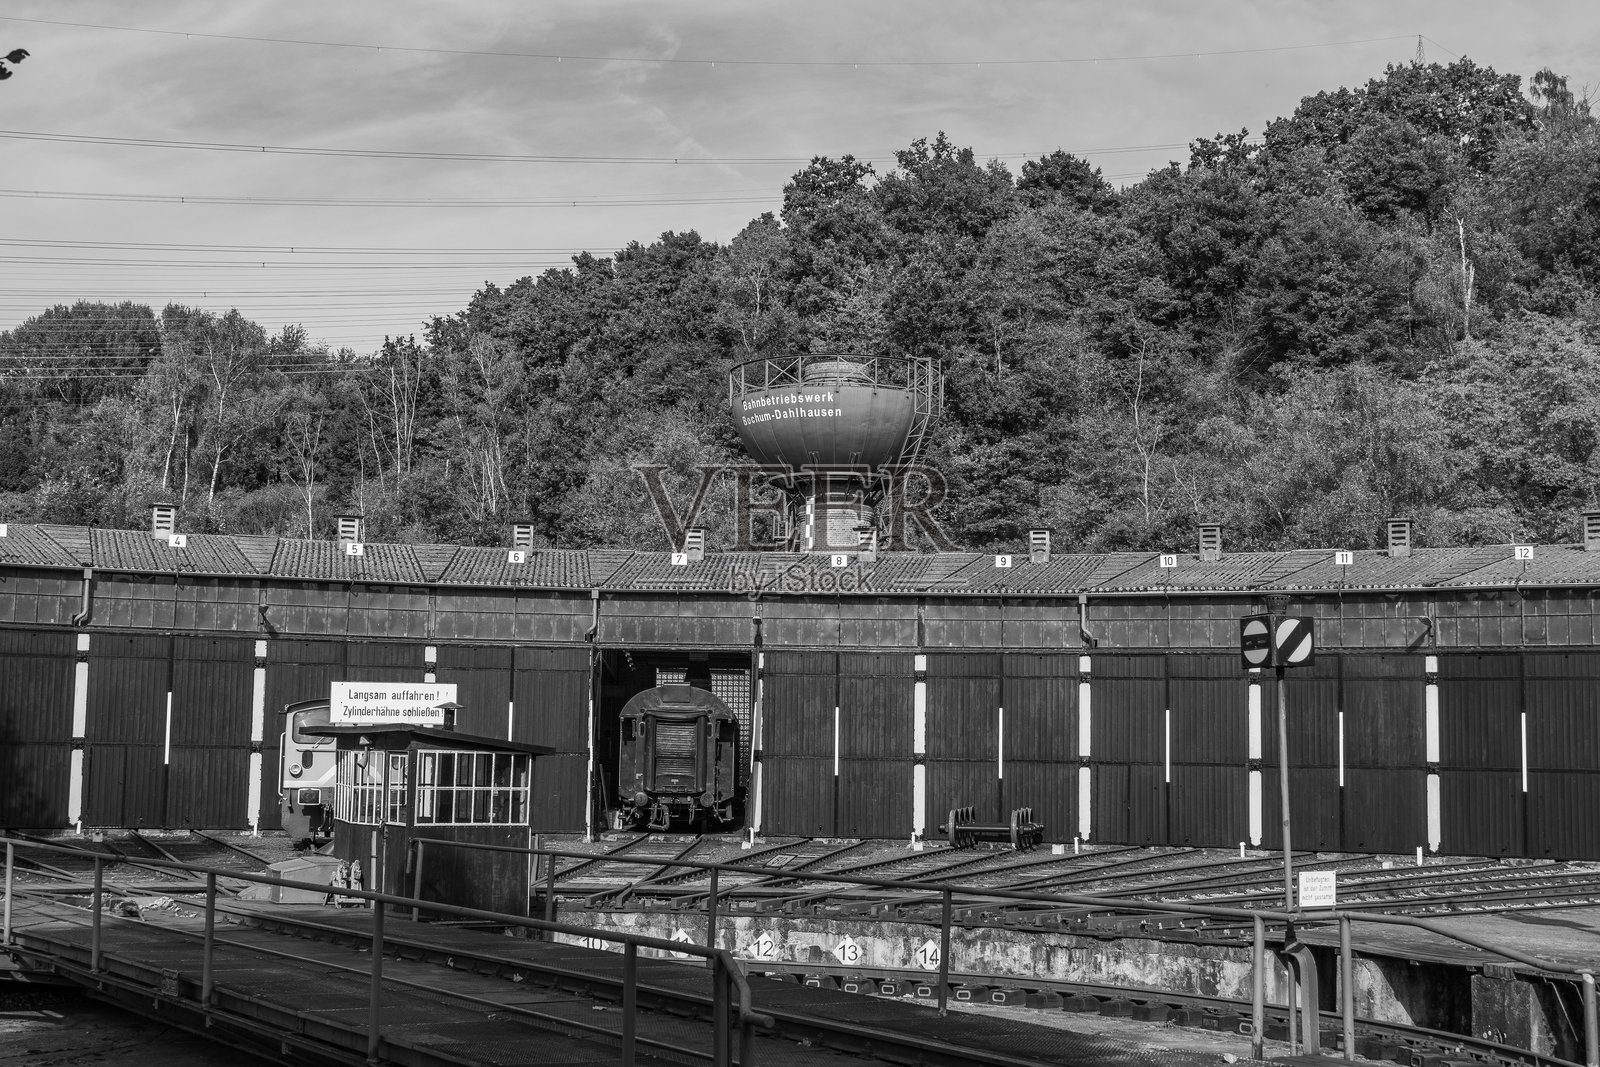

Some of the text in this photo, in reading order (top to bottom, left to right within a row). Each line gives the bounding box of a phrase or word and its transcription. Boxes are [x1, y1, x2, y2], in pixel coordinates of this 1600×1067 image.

[742, 391, 834, 411] Bahnbetriebswerk
[741, 407, 842, 426] Bochum-Dahlhausen
[174, 535, 181, 546] 4
[351, 544, 358, 554] 5
[1519, 547, 1530, 558] 12
[513, 552, 520, 562] 6
[676, 554, 683, 564] 7
[836, 556, 843, 566] 8
[1000, 556, 1007, 566] 9
[1163, 556, 1174, 566] 10
[1341, 553, 1349, 563] 11
[348, 689, 387, 702] Langsam
[343, 705, 400, 718] Zylinderhähne
[753, 940, 774, 957] 12
[838, 944, 858, 961] 13
[919, 947, 940, 965] 14
